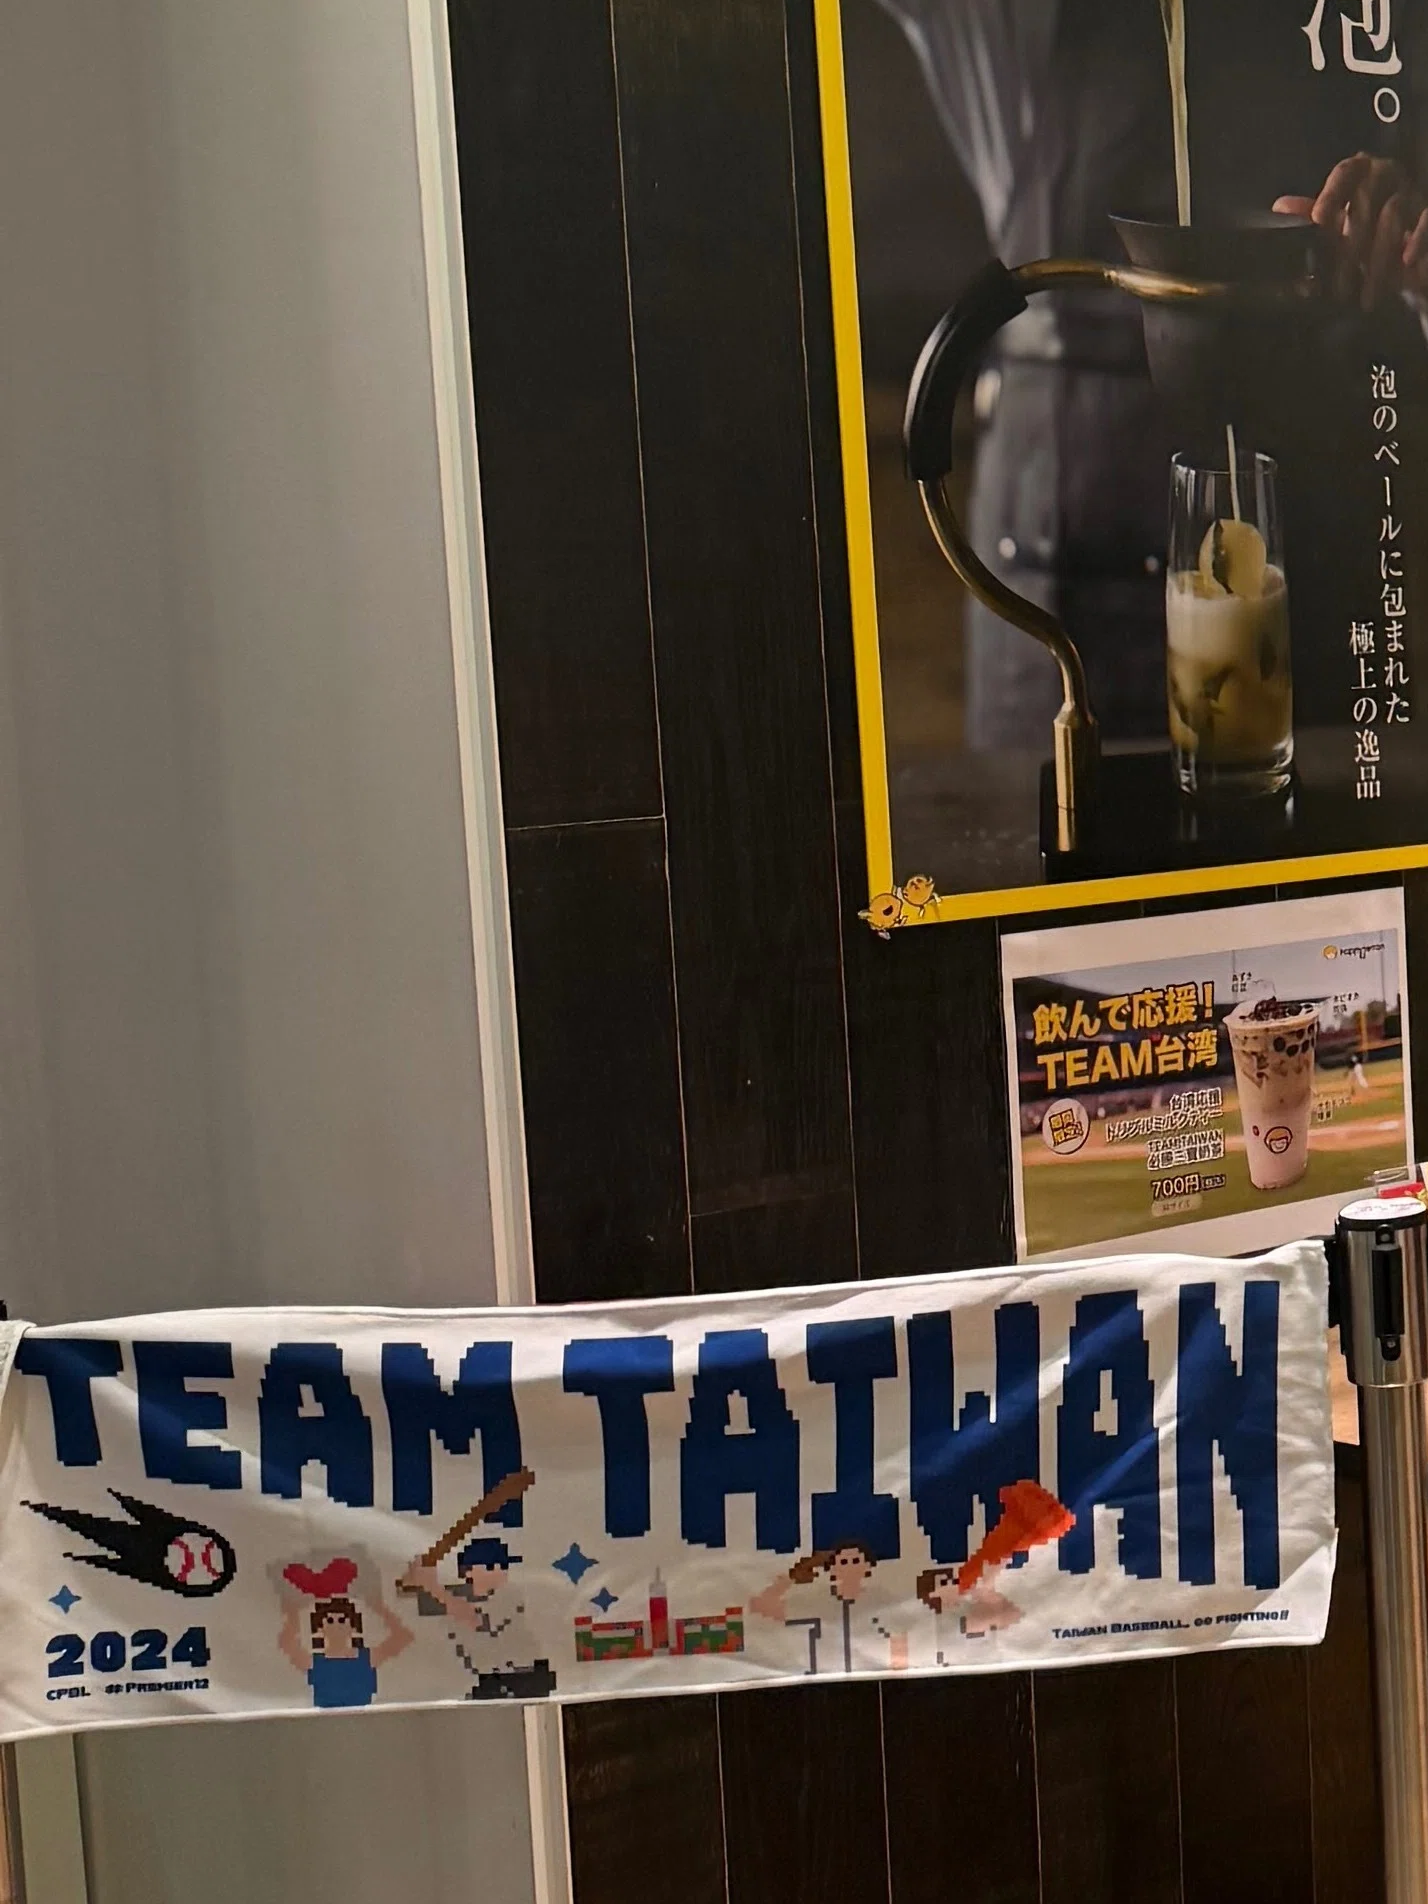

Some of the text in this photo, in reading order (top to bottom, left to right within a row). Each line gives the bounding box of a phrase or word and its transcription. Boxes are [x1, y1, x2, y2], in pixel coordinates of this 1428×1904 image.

[1370, 364, 1411, 725] 泡のベールに包まれた
[1348, 620, 1382, 800] 極上の逸品
[1037, 1028, 1219, 1091] TEAM台湾
[1151, 1173, 1200, 1200] 700円
[15, 1280, 1281, 1590] TEAM TAIWAN
[46, 1626, 211, 1679] 2024
